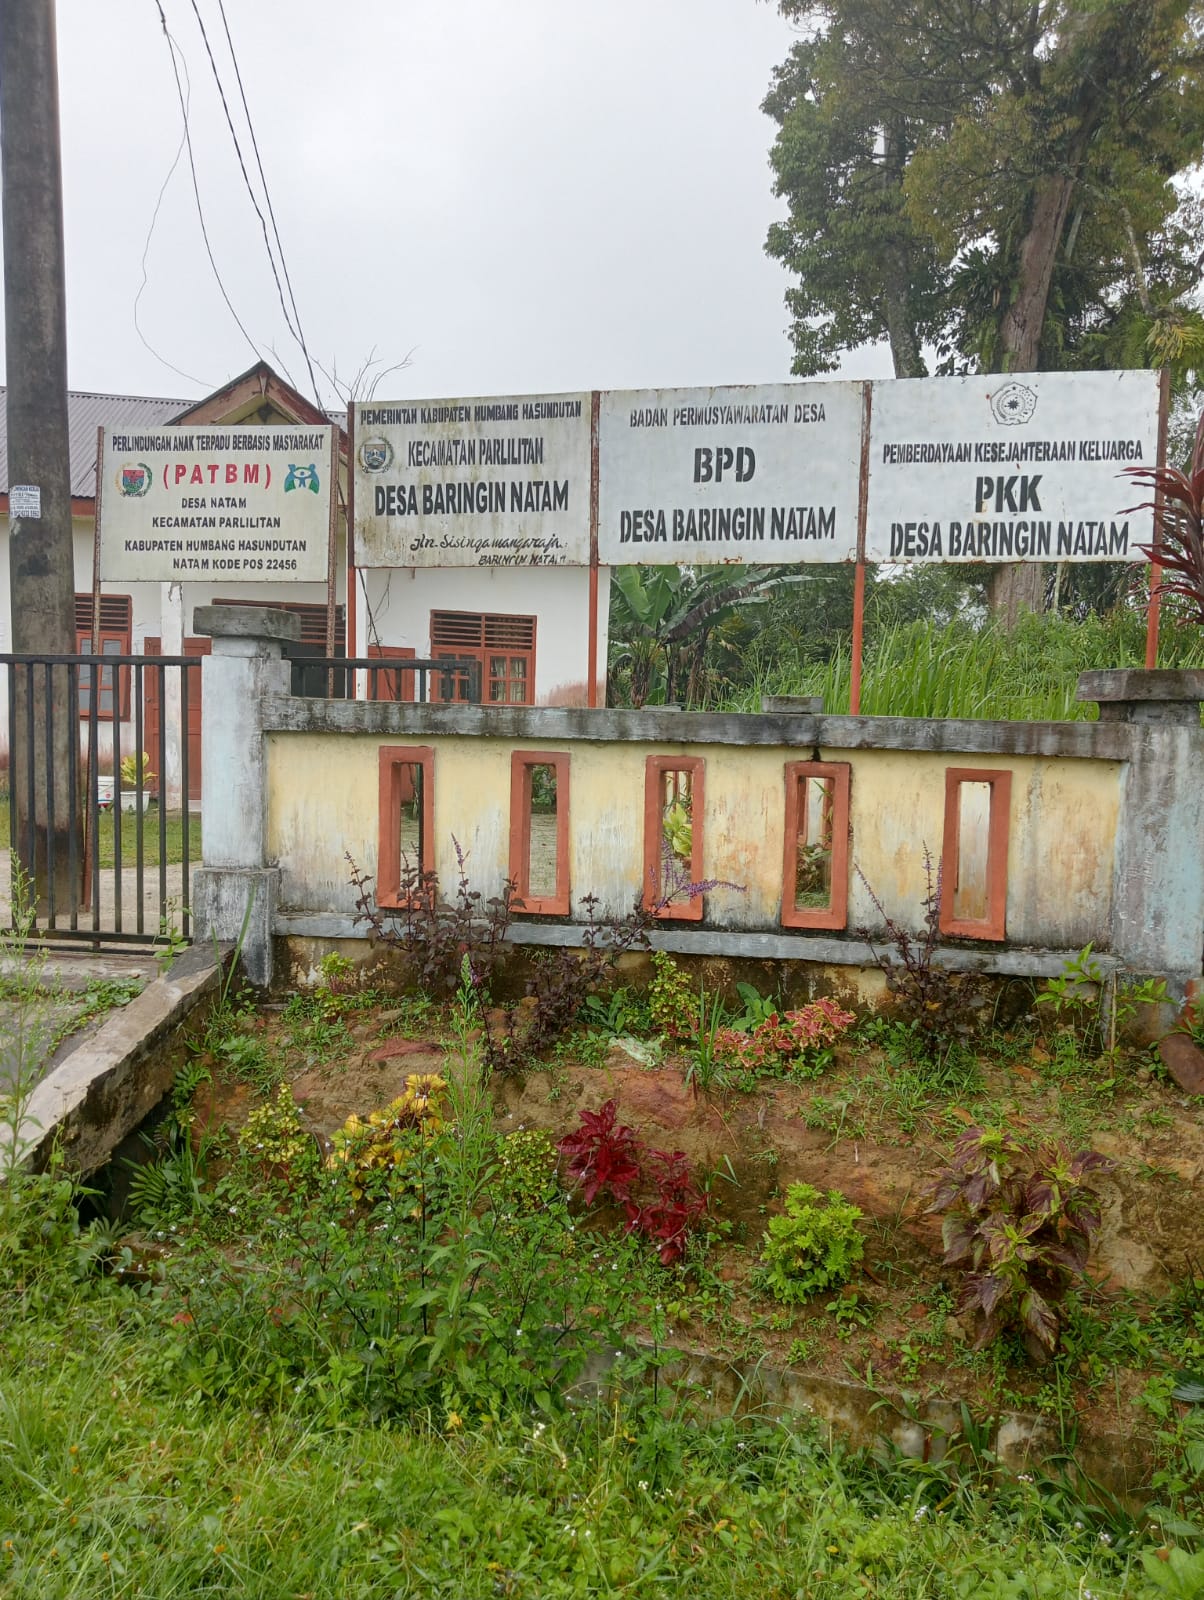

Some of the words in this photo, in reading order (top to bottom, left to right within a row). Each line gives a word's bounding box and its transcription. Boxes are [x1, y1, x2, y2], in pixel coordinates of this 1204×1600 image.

[360, 408, 417, 426] PEMERINTAH
[420, 406, 471, 424] KABUPATEN
[474, 403, 519, 422] HUMBANG
[522, 400, 582, 420] HASUNDUTAN
[630, 408, 668, 428] BADAN
[672, 404, 788, 426] PERMUSYAWARATAN
[793, 403, 826, 424] DESA
[112, 435, 173, 452] PERLINDUNGAN
[172, 434, 195, 452] ANAK
[196, 434, 231, 451] TERPADU
[232, 434, 271, 451] BERBASIS
[272, 433, 325, 451] MASYARAKAT
[408, 438, 476, 467] KECAMATAN
[479, 437, 544, 465] PARLILITAN
[882, 442, 972, 464] PEMBERDAYAAN
[974, 441, 1076, 463] KESEJAHTERAAN
[1078, 439, 1143, 461] KELUARGA
[693, 446, 756, 483] BPD
[181, 497, 207, 509] DESA
[210, 497, 247, 508] NATAM
[375, 485, 418, 516] DESA
[422, 481, 506, 515] BARINGIN
[510, 479, 569, 513] NATAM
[975, 474, 1043, 513] PKK
[152, 516, 216, 528] KECAMATAN
[218, 516, 281, 528] PARLILITAN
[619, 510, 668, 543] DESA
[672, 507, 766, 542] BARINGIN
[770, 506, 836, 541] NATAM
[124, 540, 183, 551] KABUPATEN
[186, 540, 235, 551] HUMBANG
[238, 540, 306, 551] HASUNDUTAN
[889, 522, 943, 557] DESA
[949, 521, 1051, 556] BARINGIN
[1056, 521, 1129, 556] NATAM
[173, 558, 209, 570] NATAM
[212, 558, 241, 570] KODE
[242, 558, 263, 570] POS
[265, 558, 297, 570] 22456
